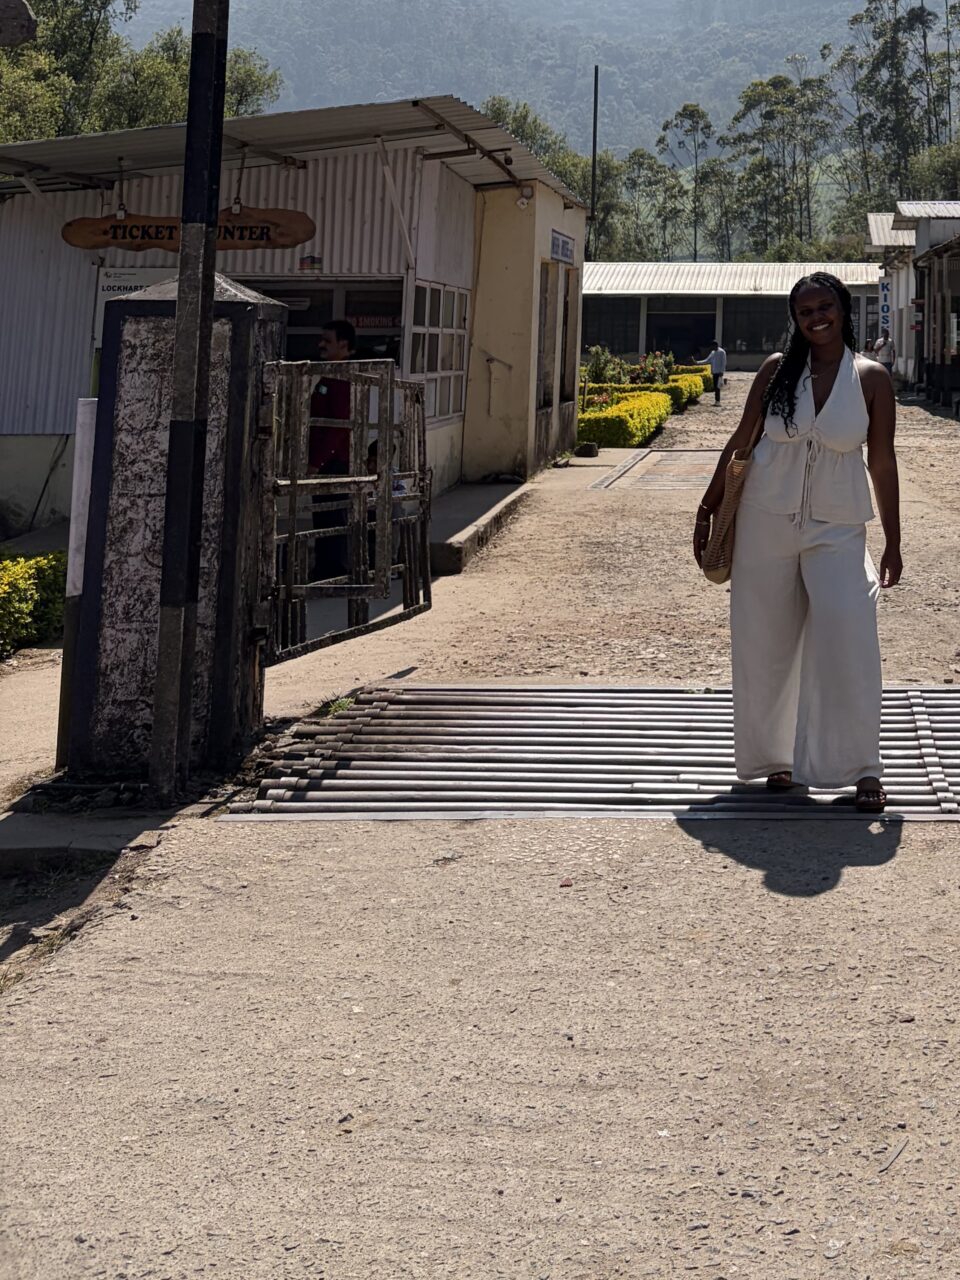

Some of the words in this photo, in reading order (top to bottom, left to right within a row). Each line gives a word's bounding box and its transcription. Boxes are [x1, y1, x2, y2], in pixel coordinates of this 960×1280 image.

[109, 224, 177, 241] TICKET
[217, 224, 271, 241] NTER
[101, 284, 144, 292] LOCKHART
[881, 282, 890, 329] KIOS
